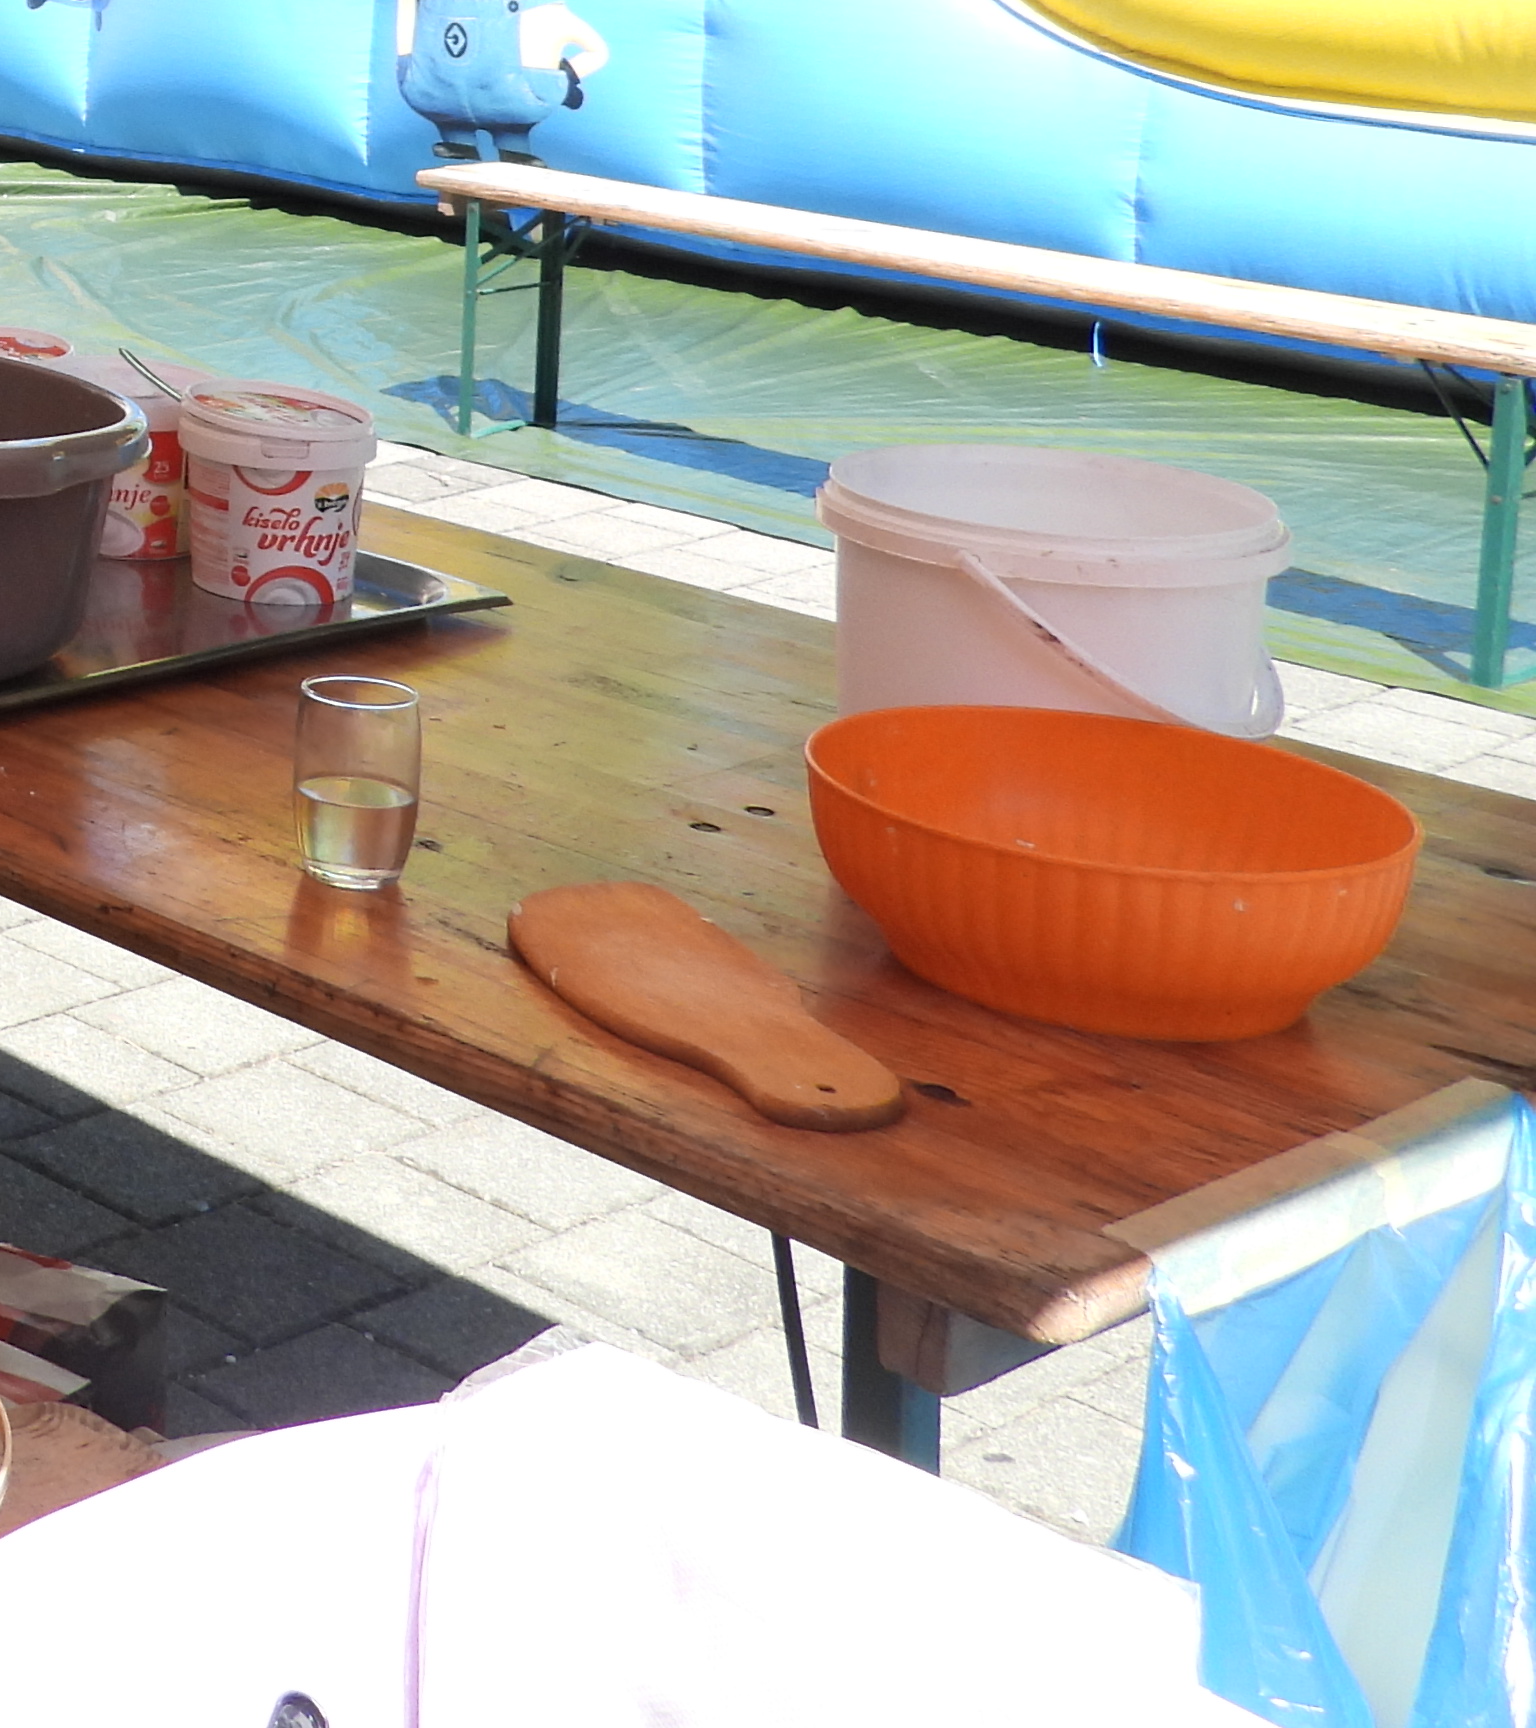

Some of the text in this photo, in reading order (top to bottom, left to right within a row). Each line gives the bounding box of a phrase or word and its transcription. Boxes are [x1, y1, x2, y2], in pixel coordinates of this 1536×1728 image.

[109, 484, 152, 511] nje
[242, 506, 301, 531] kiselo
[257, 516, 350, 566] vrhnje
